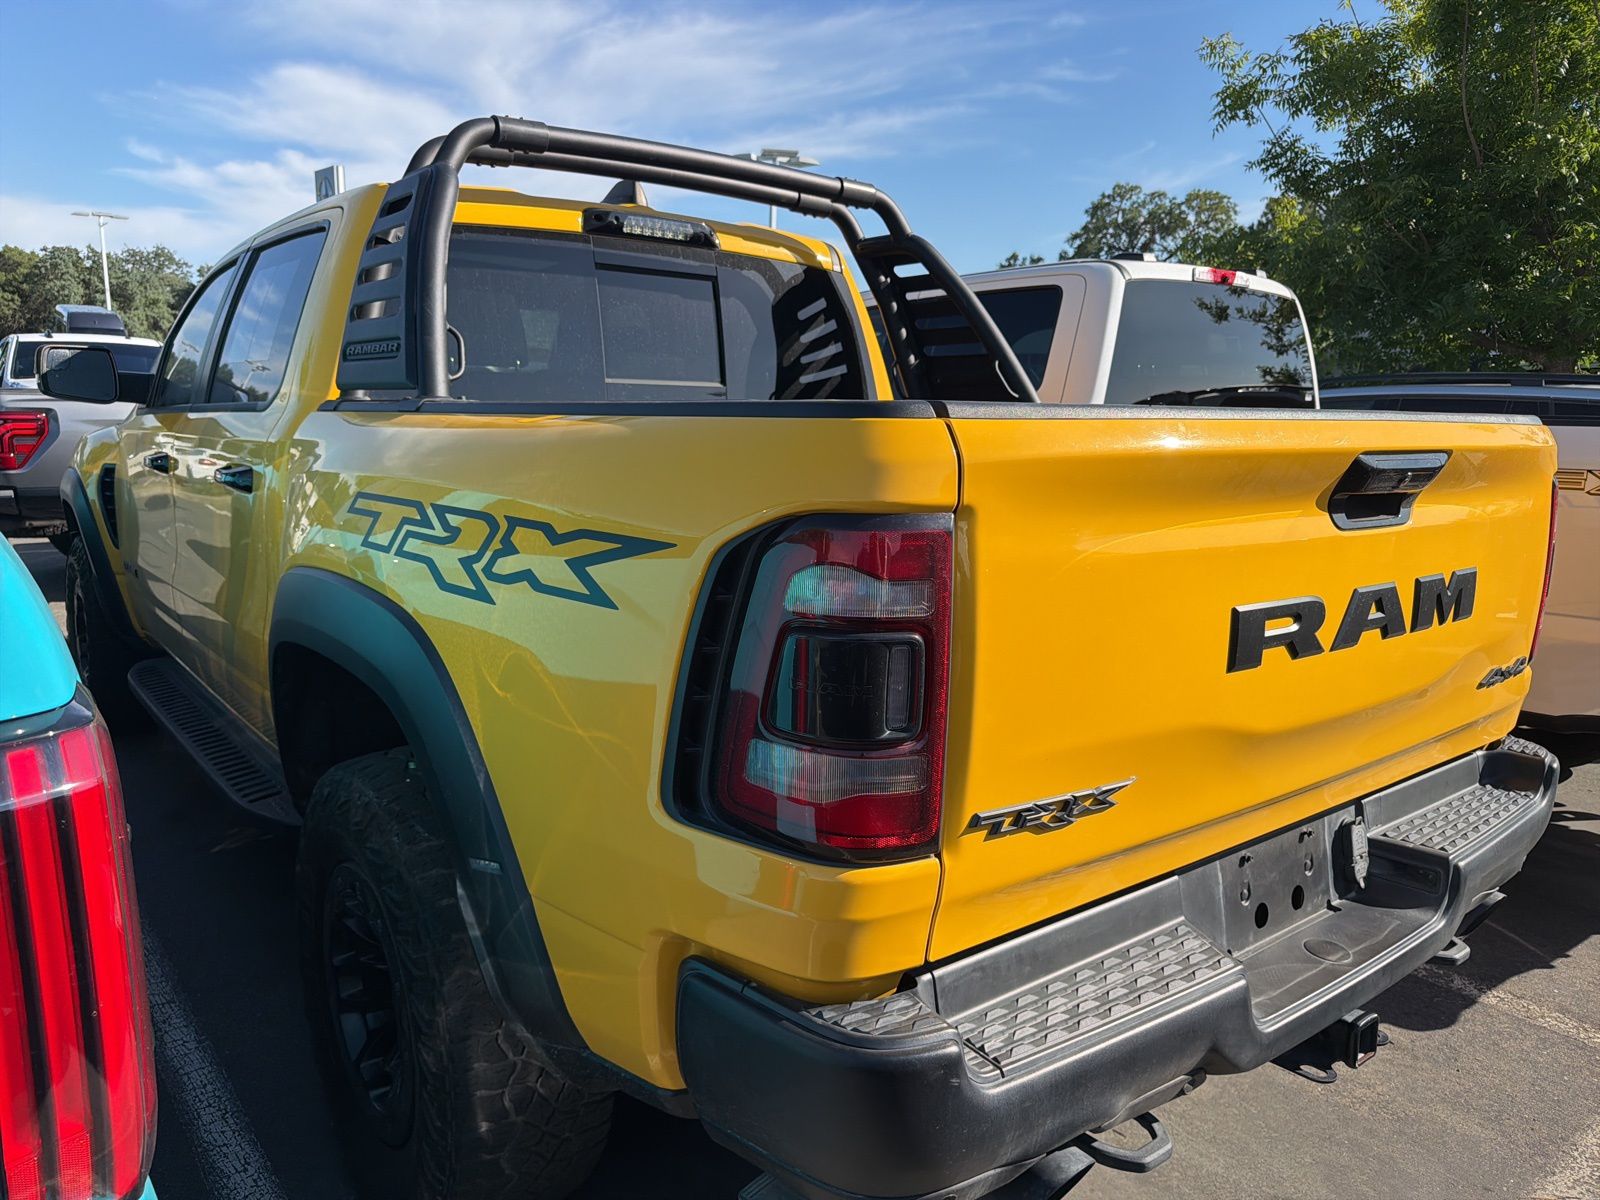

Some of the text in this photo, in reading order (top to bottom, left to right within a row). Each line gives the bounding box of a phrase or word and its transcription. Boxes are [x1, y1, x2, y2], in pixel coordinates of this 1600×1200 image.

[346, 341, 399, 356] RAMBAR
[347, 491, 679, 611] TRX
[1226, 566, 1478, 674] RAM
[963, 775, 1137, 840] TRX
